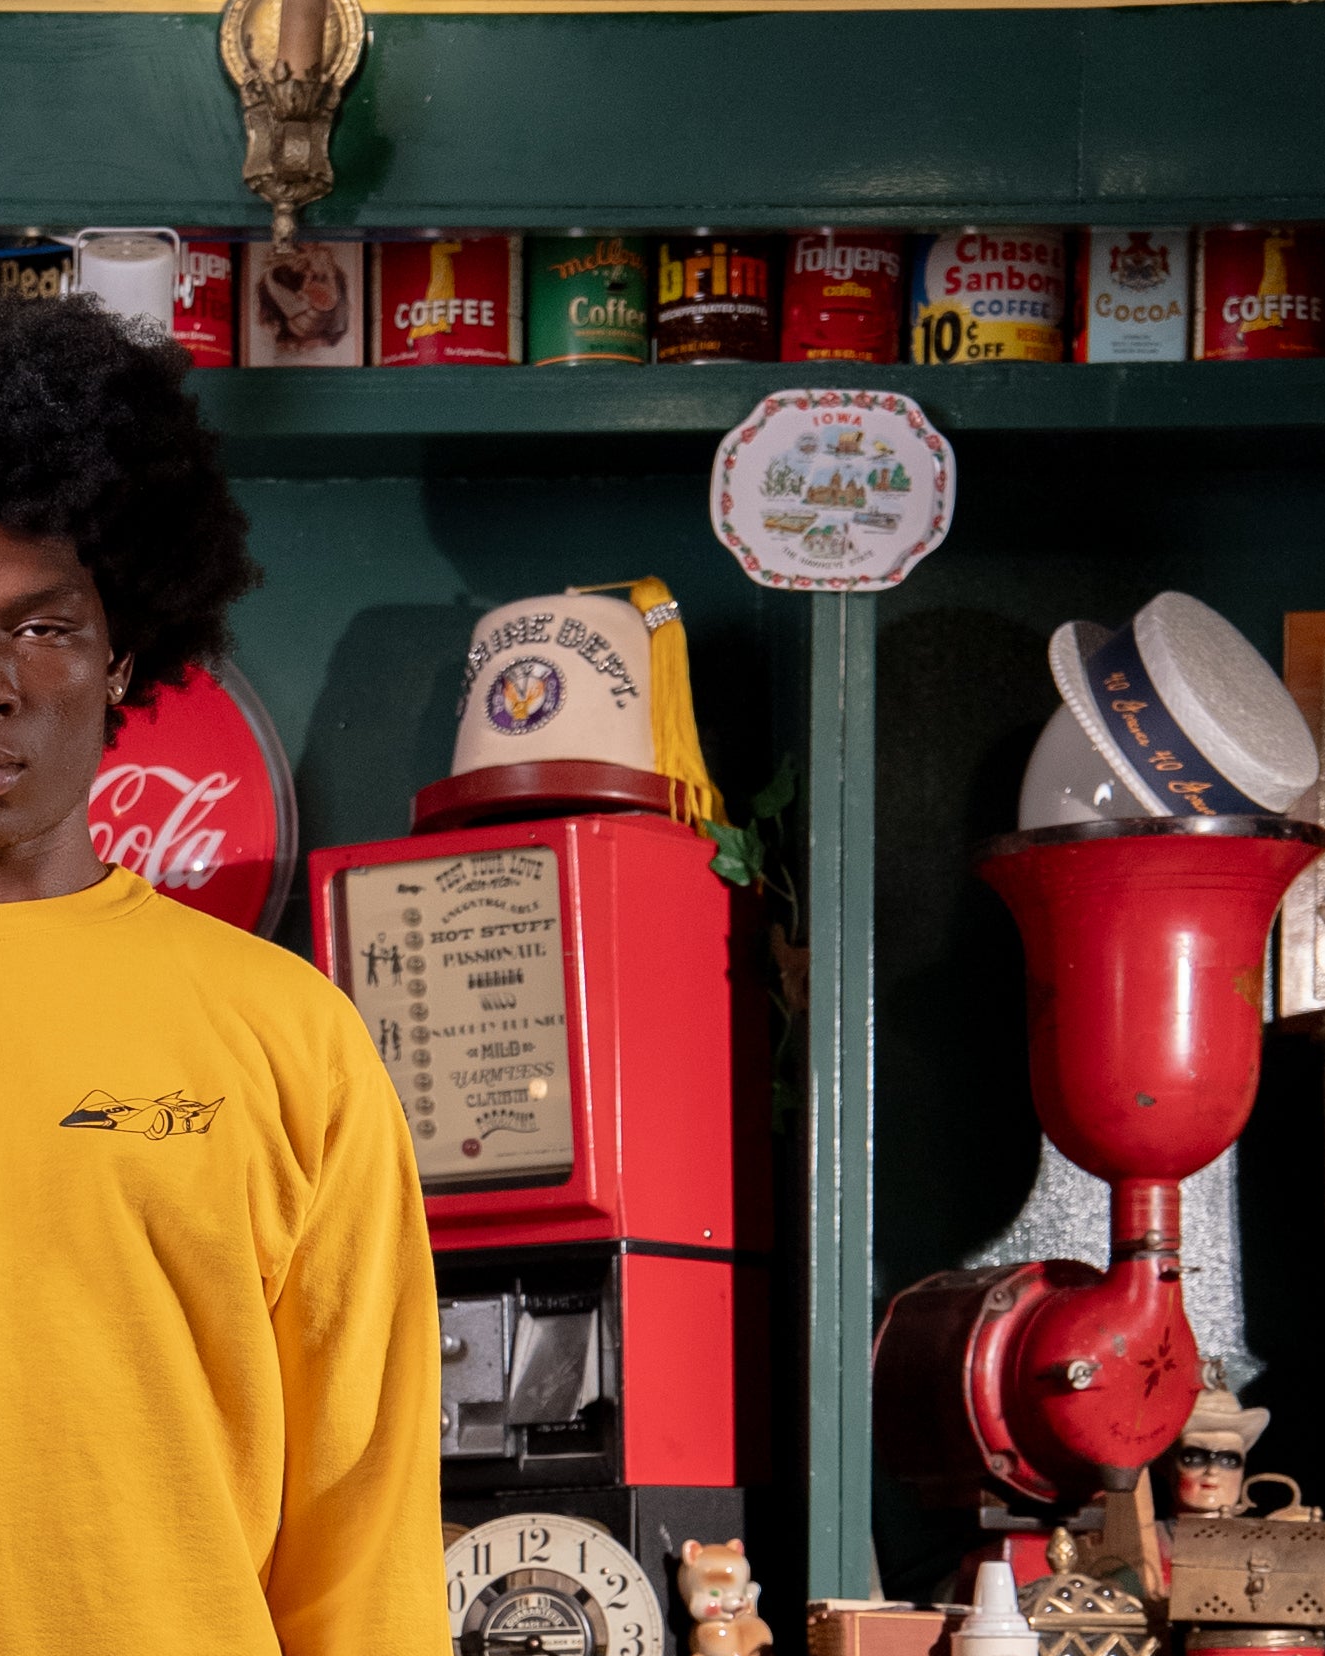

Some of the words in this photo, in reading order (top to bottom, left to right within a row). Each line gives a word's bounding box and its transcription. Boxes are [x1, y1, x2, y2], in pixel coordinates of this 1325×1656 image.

[795, 234, 901, 281] Folgers
[955, 235, 1049, 264] Chase
[658, 242, 767, 305] brim
[823, 282, 873, 298] coffee
[394, 299, 495, 330] COFFEE
[1094, 292, 1182, 324] COCOA
[1222, 295, 1322, 324] COFFEE
[966, 342, 1006, 358] OFF
[813, 412, 863, 427] IOWA
[429, 927, 475, 944] HOT
[480, 917, 557, 939] STUFF
[470, 1543, 492, 1576] 11
[517, 1527, 551, 1563] 12
[578, 1540, 589, 1574] 1
[606, 1573, 628, 1610] 2
